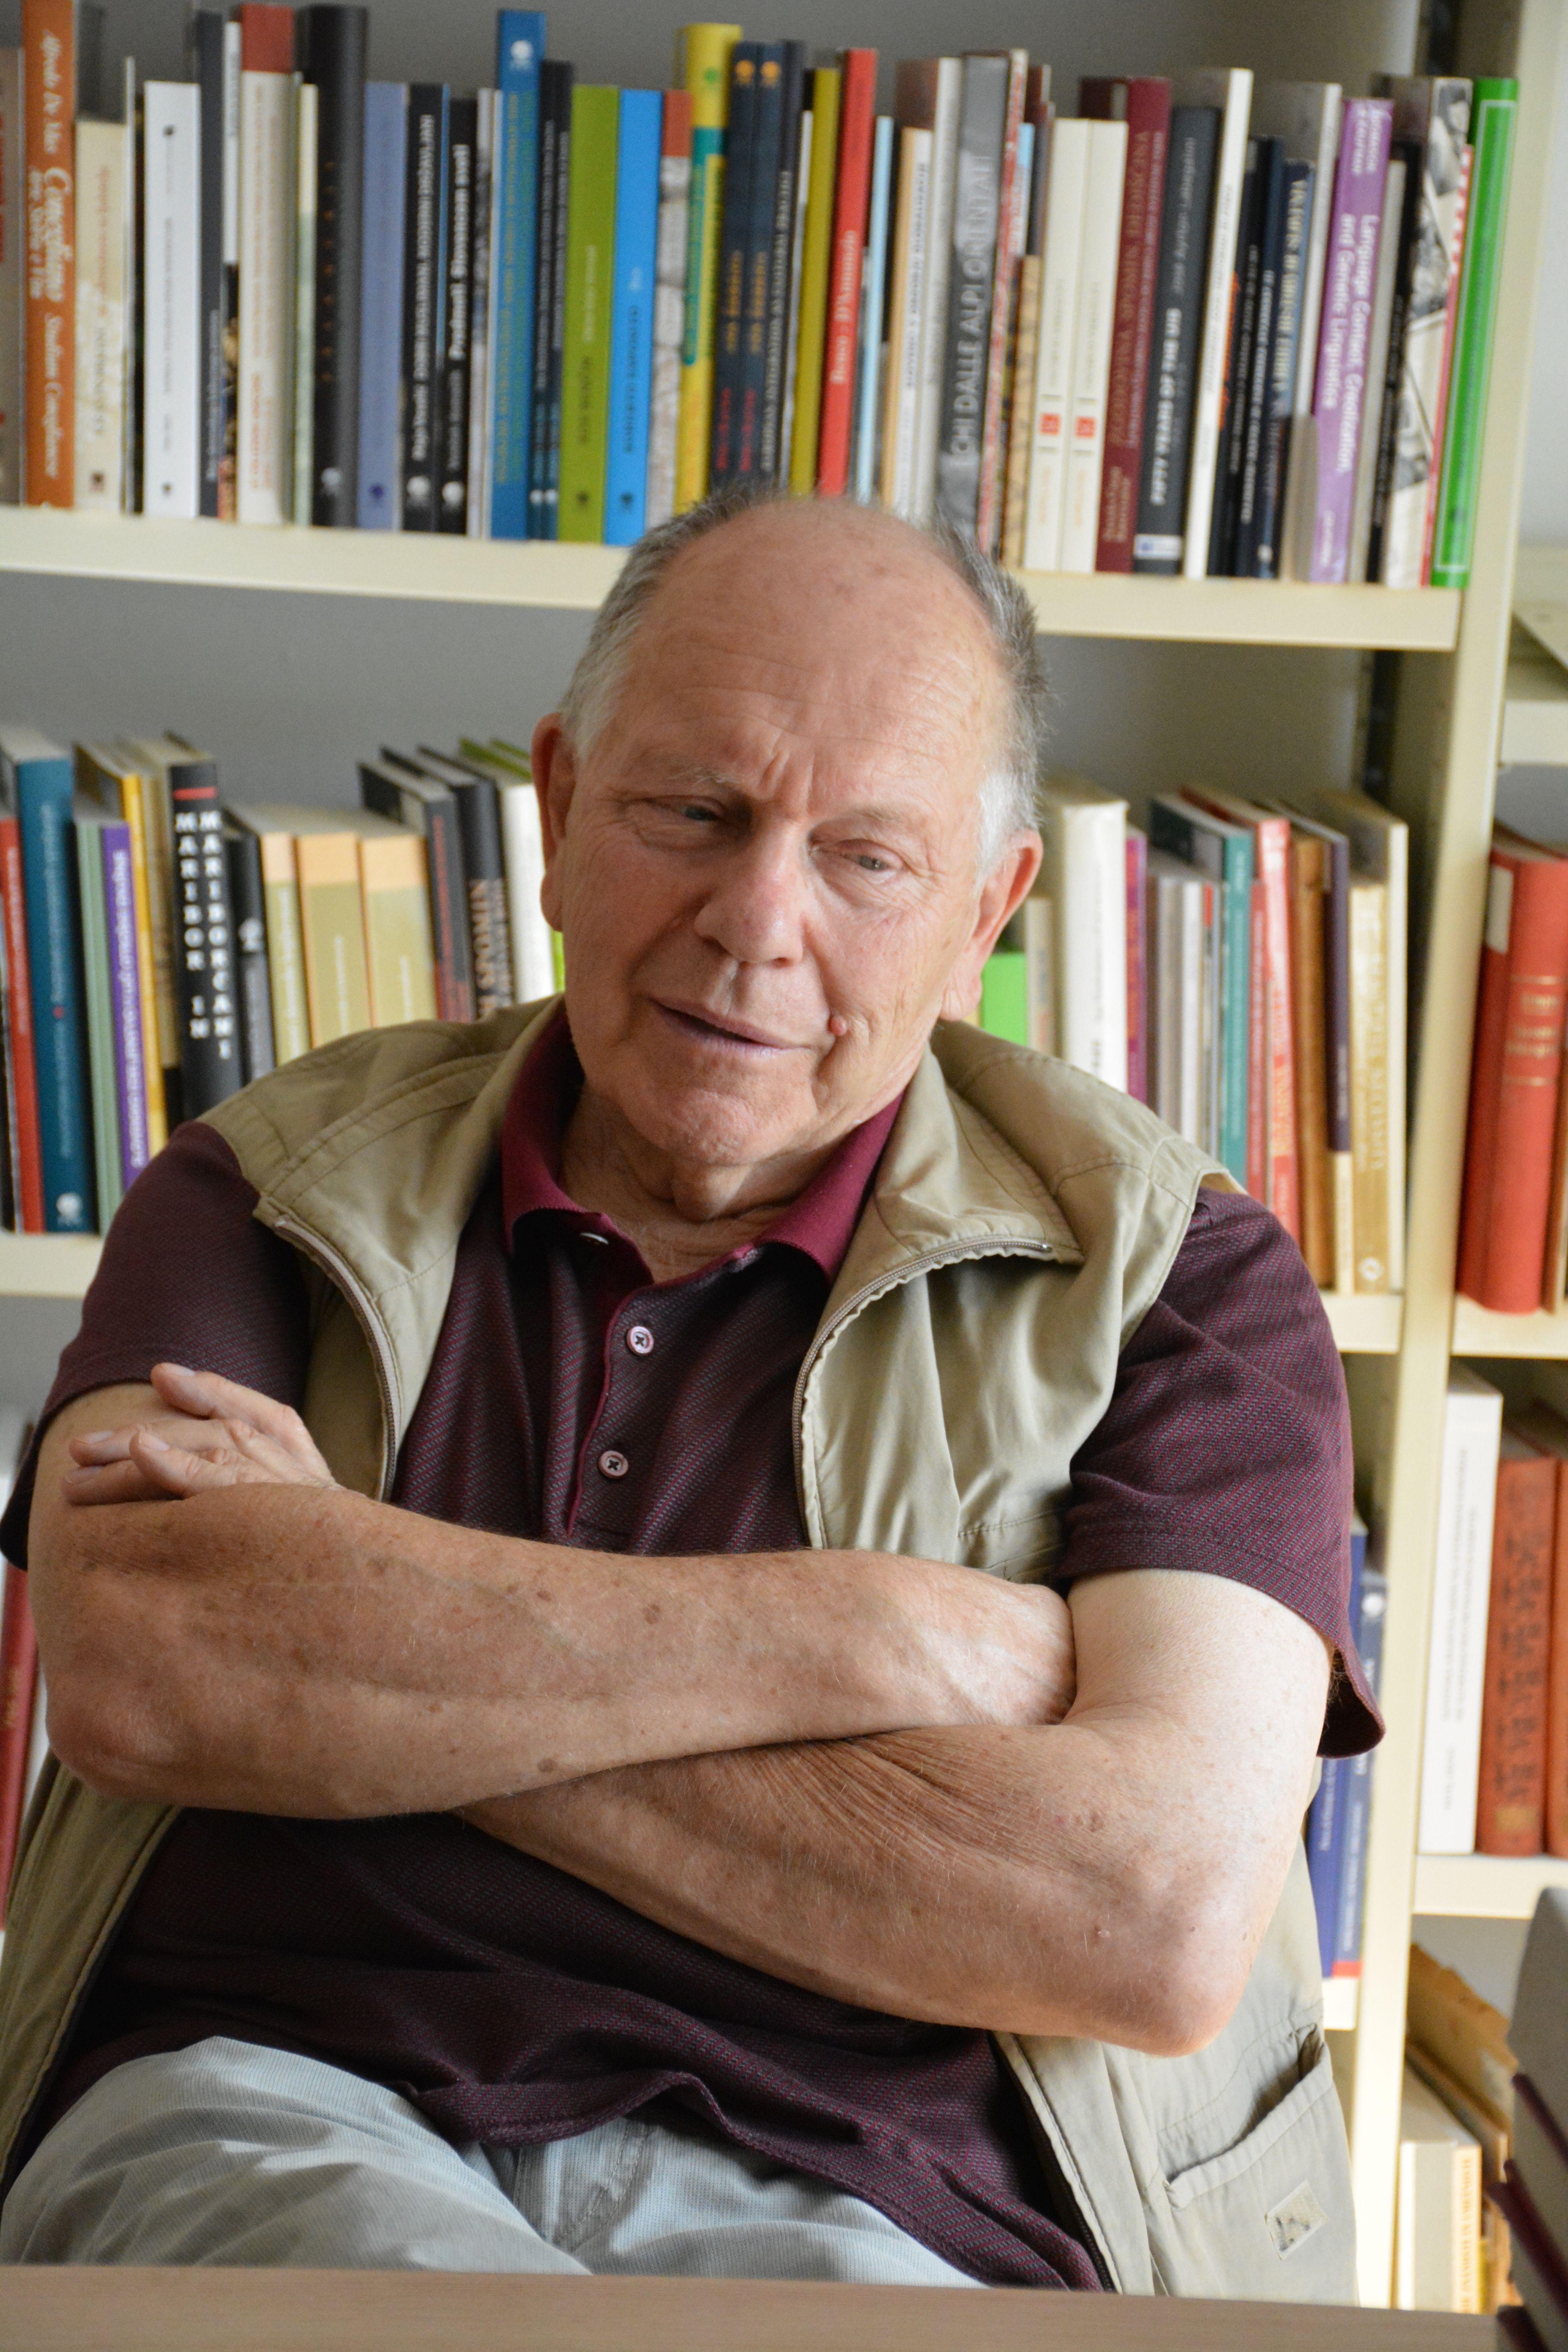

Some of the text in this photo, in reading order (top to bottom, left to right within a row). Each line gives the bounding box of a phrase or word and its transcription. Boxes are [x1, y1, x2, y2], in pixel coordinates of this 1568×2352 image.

[42, 29, 61, 155] Alfredo De Mas
[40, 166, 73, 302] Conegliano
[963, 152, 994, 279] ORIENTALI
[1172, 211, 1192, 260] Ayrton
[835, 229, 859, 323] D'Annunzio
[959, 283, 985, 335] ALPI
[1169, 263, 1186, 296] José
[1320, 213, 1357, 410] and Genetic Linguistics
[626, 306, 640, 378] ESPOSITO
[831, 335, 849, 385] Benco
[953, 339, 982, 414] DALLE
[1335, 213, 1379, 475] Language Contact, Creolization,
[42, 313, 62, 479] Studium Coneglianese
[623, 383, 637, 453] ROBERTO
[1150, 307, 1182, 506] FIFTY YEARS OF THE UIS
[112, 849, 132, 908] IZKUŠNJE
[116, 909, 135, 967] OTROŠKE
[174, 811, 210, 1039] MARIBOR IN
[200, 809, 234, 1061] MARIBORČANI
[120, 968, 136, 996] LUČI
[122, 1006, 143, 1092] IZSELJENSTVO
[1367, 953, 1385, 1170] BEAUTIFUL NECESSITY
[129, 1094, 147, 1167] SLOVENSKO
